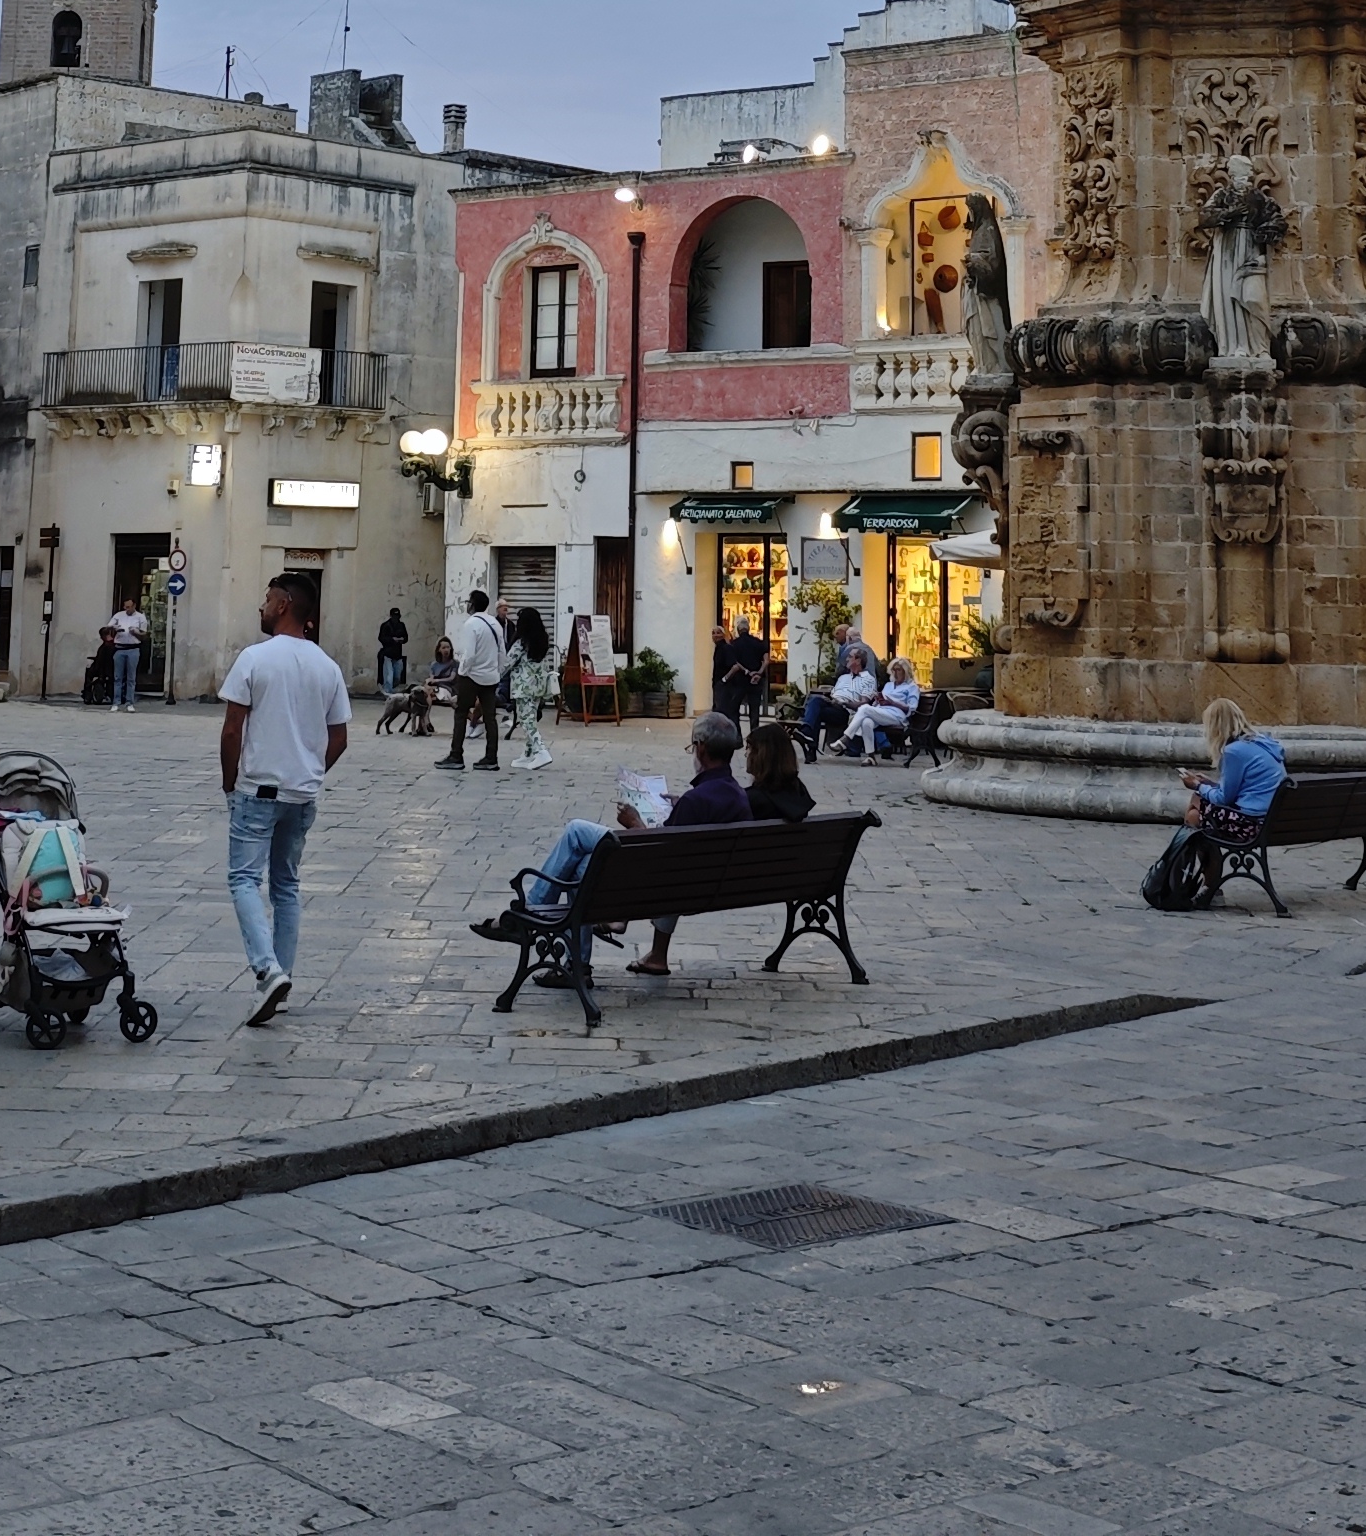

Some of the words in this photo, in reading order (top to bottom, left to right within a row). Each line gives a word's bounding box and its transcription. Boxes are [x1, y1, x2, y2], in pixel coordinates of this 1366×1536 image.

[679, 508, 724, 519] ARTIGIANATO
[724, 509, 763, 519] SALENTINO
[862, 517, 919, 529] TERRAROSSA
